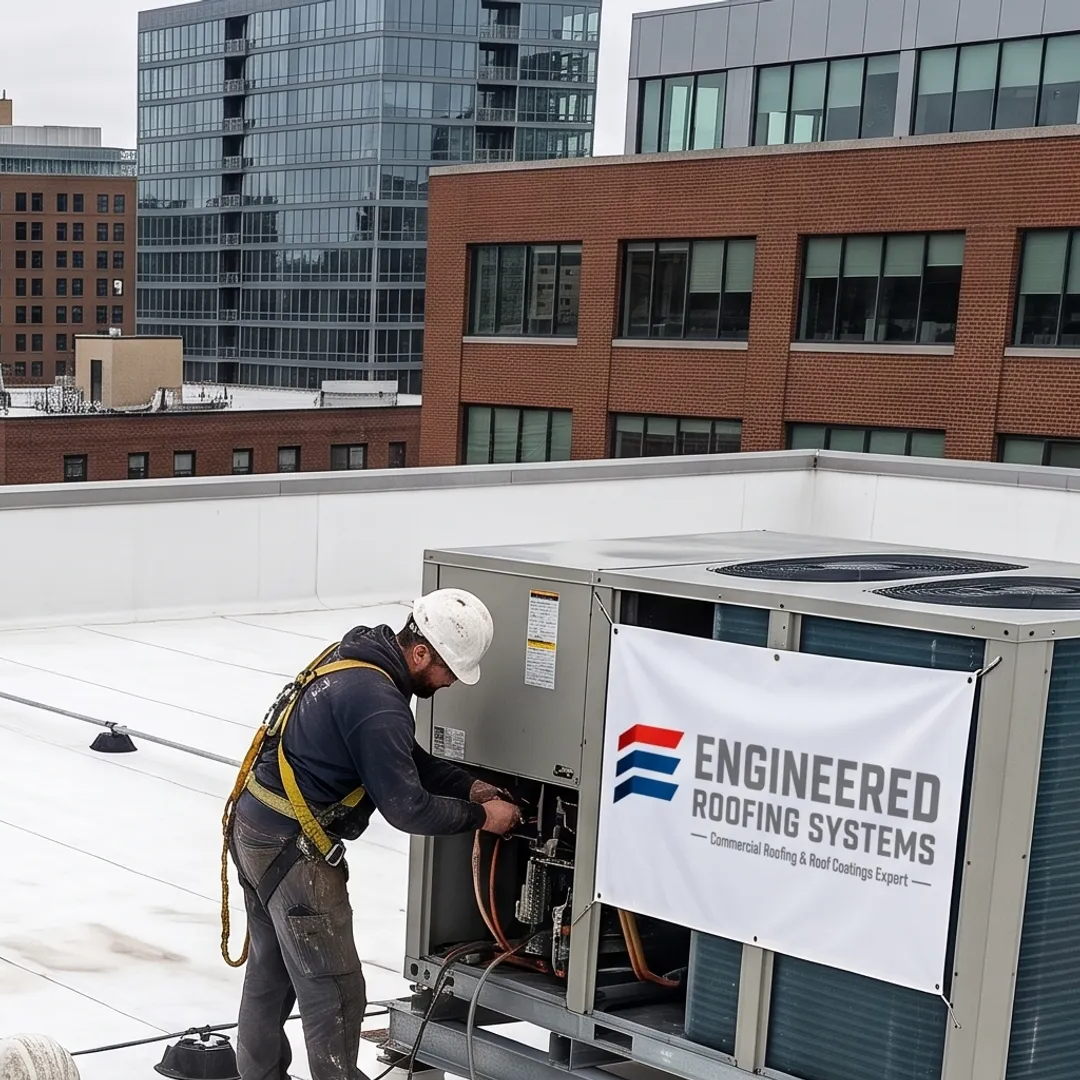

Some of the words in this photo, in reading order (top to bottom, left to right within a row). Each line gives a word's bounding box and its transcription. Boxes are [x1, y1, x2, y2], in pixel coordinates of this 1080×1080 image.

[694, 734, 941, 824] ENGINEERED
[692, 788, 800, 839] ROOFING
[808, 812, 936, 866] SYSTEMS
[710, 831, 762, 856] Commercial
[763, 842, 798, 867] Roofing
[799, 851, 808, 866] &
[809, 853, 831, 871] Roof
[832, 857, 874, 882] Coatings
[875, 866, 909, 887] Expert
